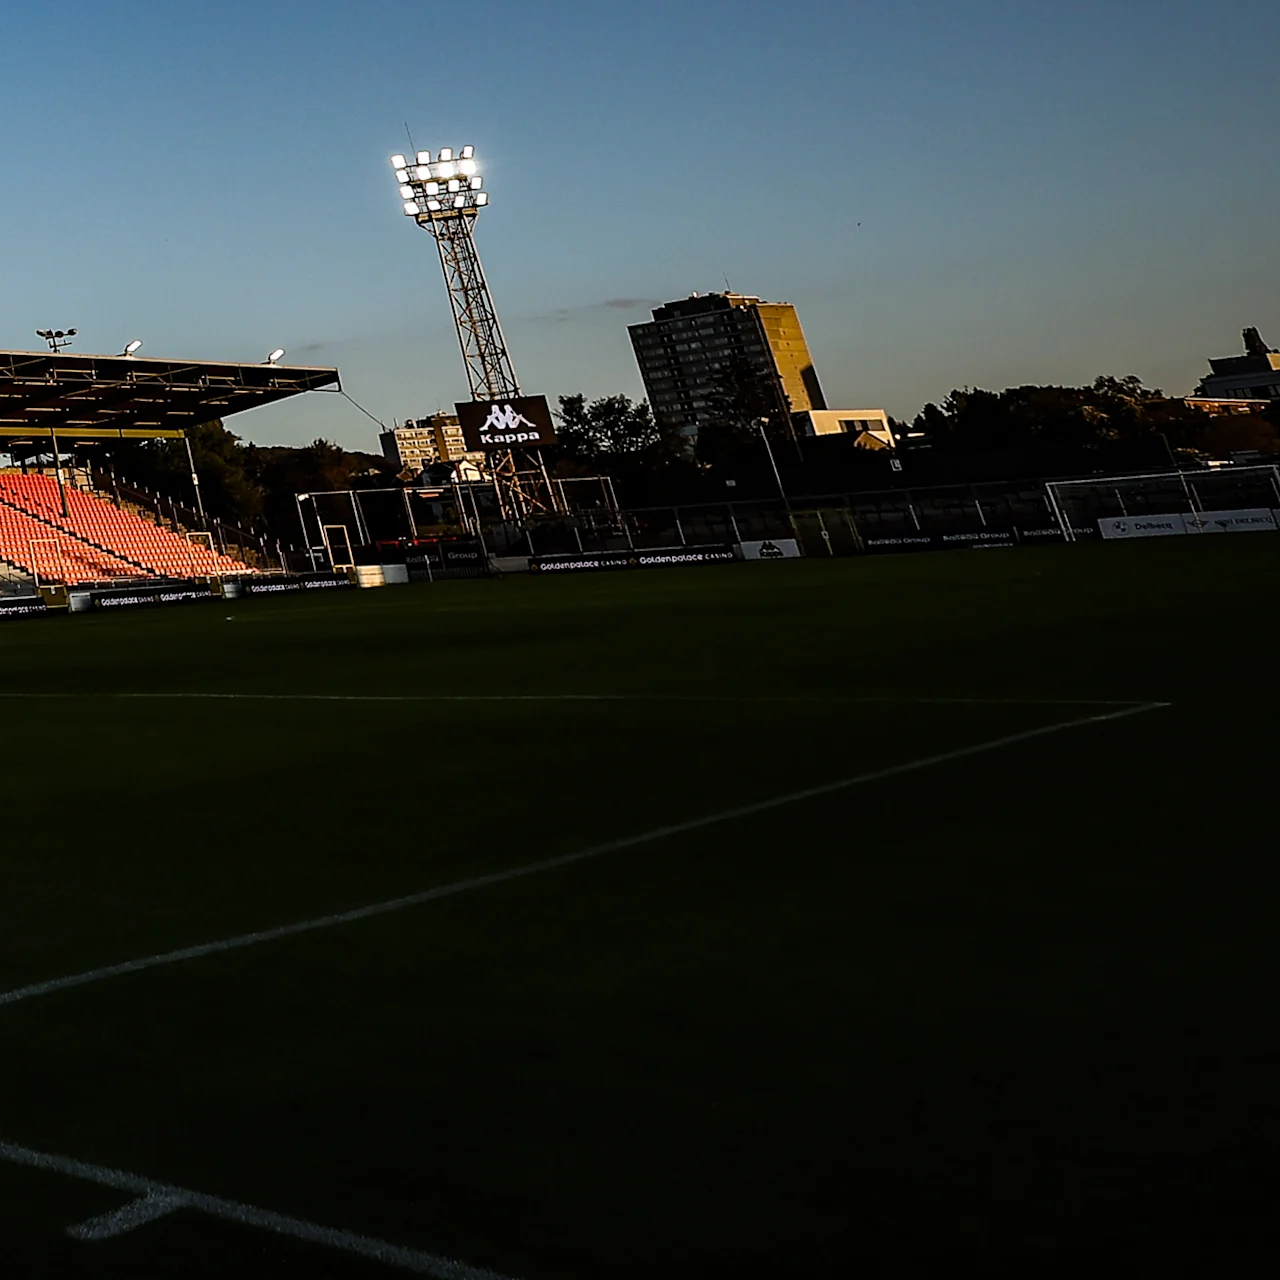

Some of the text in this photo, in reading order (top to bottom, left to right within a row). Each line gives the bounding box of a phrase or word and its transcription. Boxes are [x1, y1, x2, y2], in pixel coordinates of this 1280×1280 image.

[480, 431, 541, 444] Kappa
[640, 551, 734, 565] Goldenpalace CASINO
[540, 560, 600, 571] Goldenpalace
